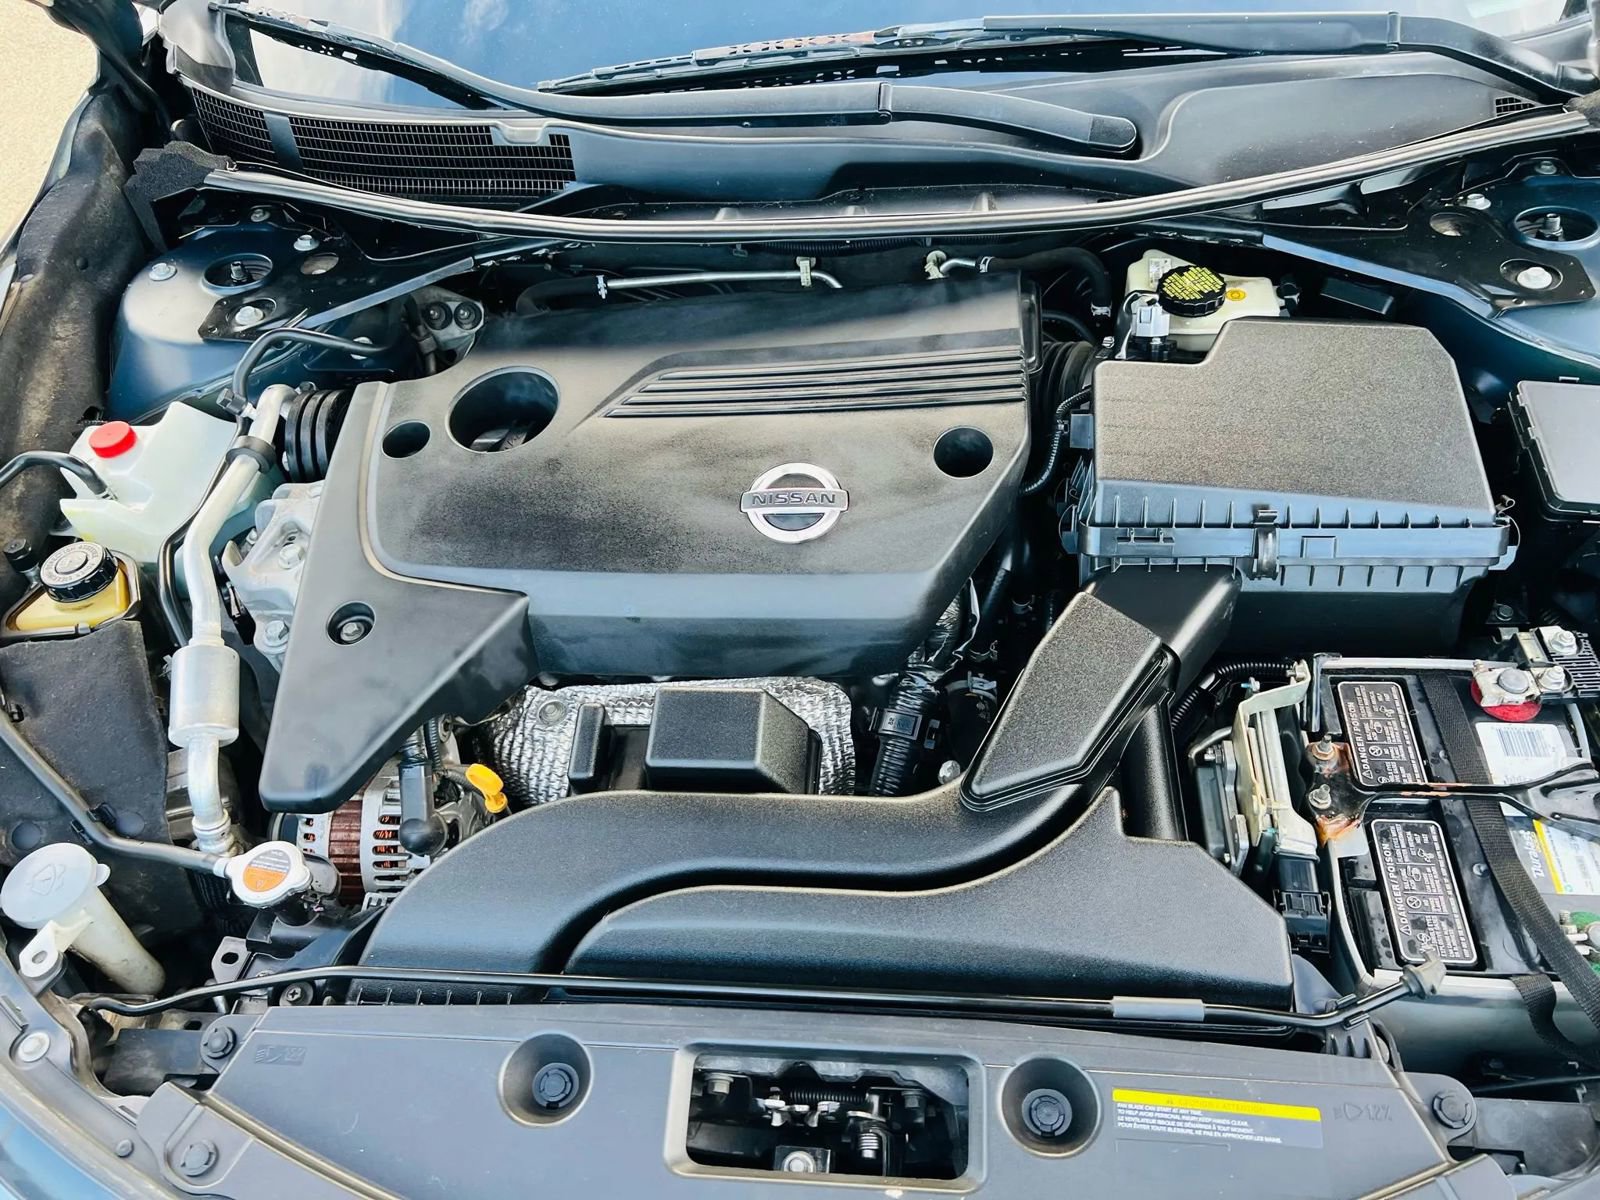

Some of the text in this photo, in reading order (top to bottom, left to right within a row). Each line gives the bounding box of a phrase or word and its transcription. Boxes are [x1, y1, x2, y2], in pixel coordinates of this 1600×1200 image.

[752, 492, 836, 505] NISSAN
[1346, 701, 1370, 769] DANGER/POISON
[1381, 843, 1408, 923] DANGER/POISON
